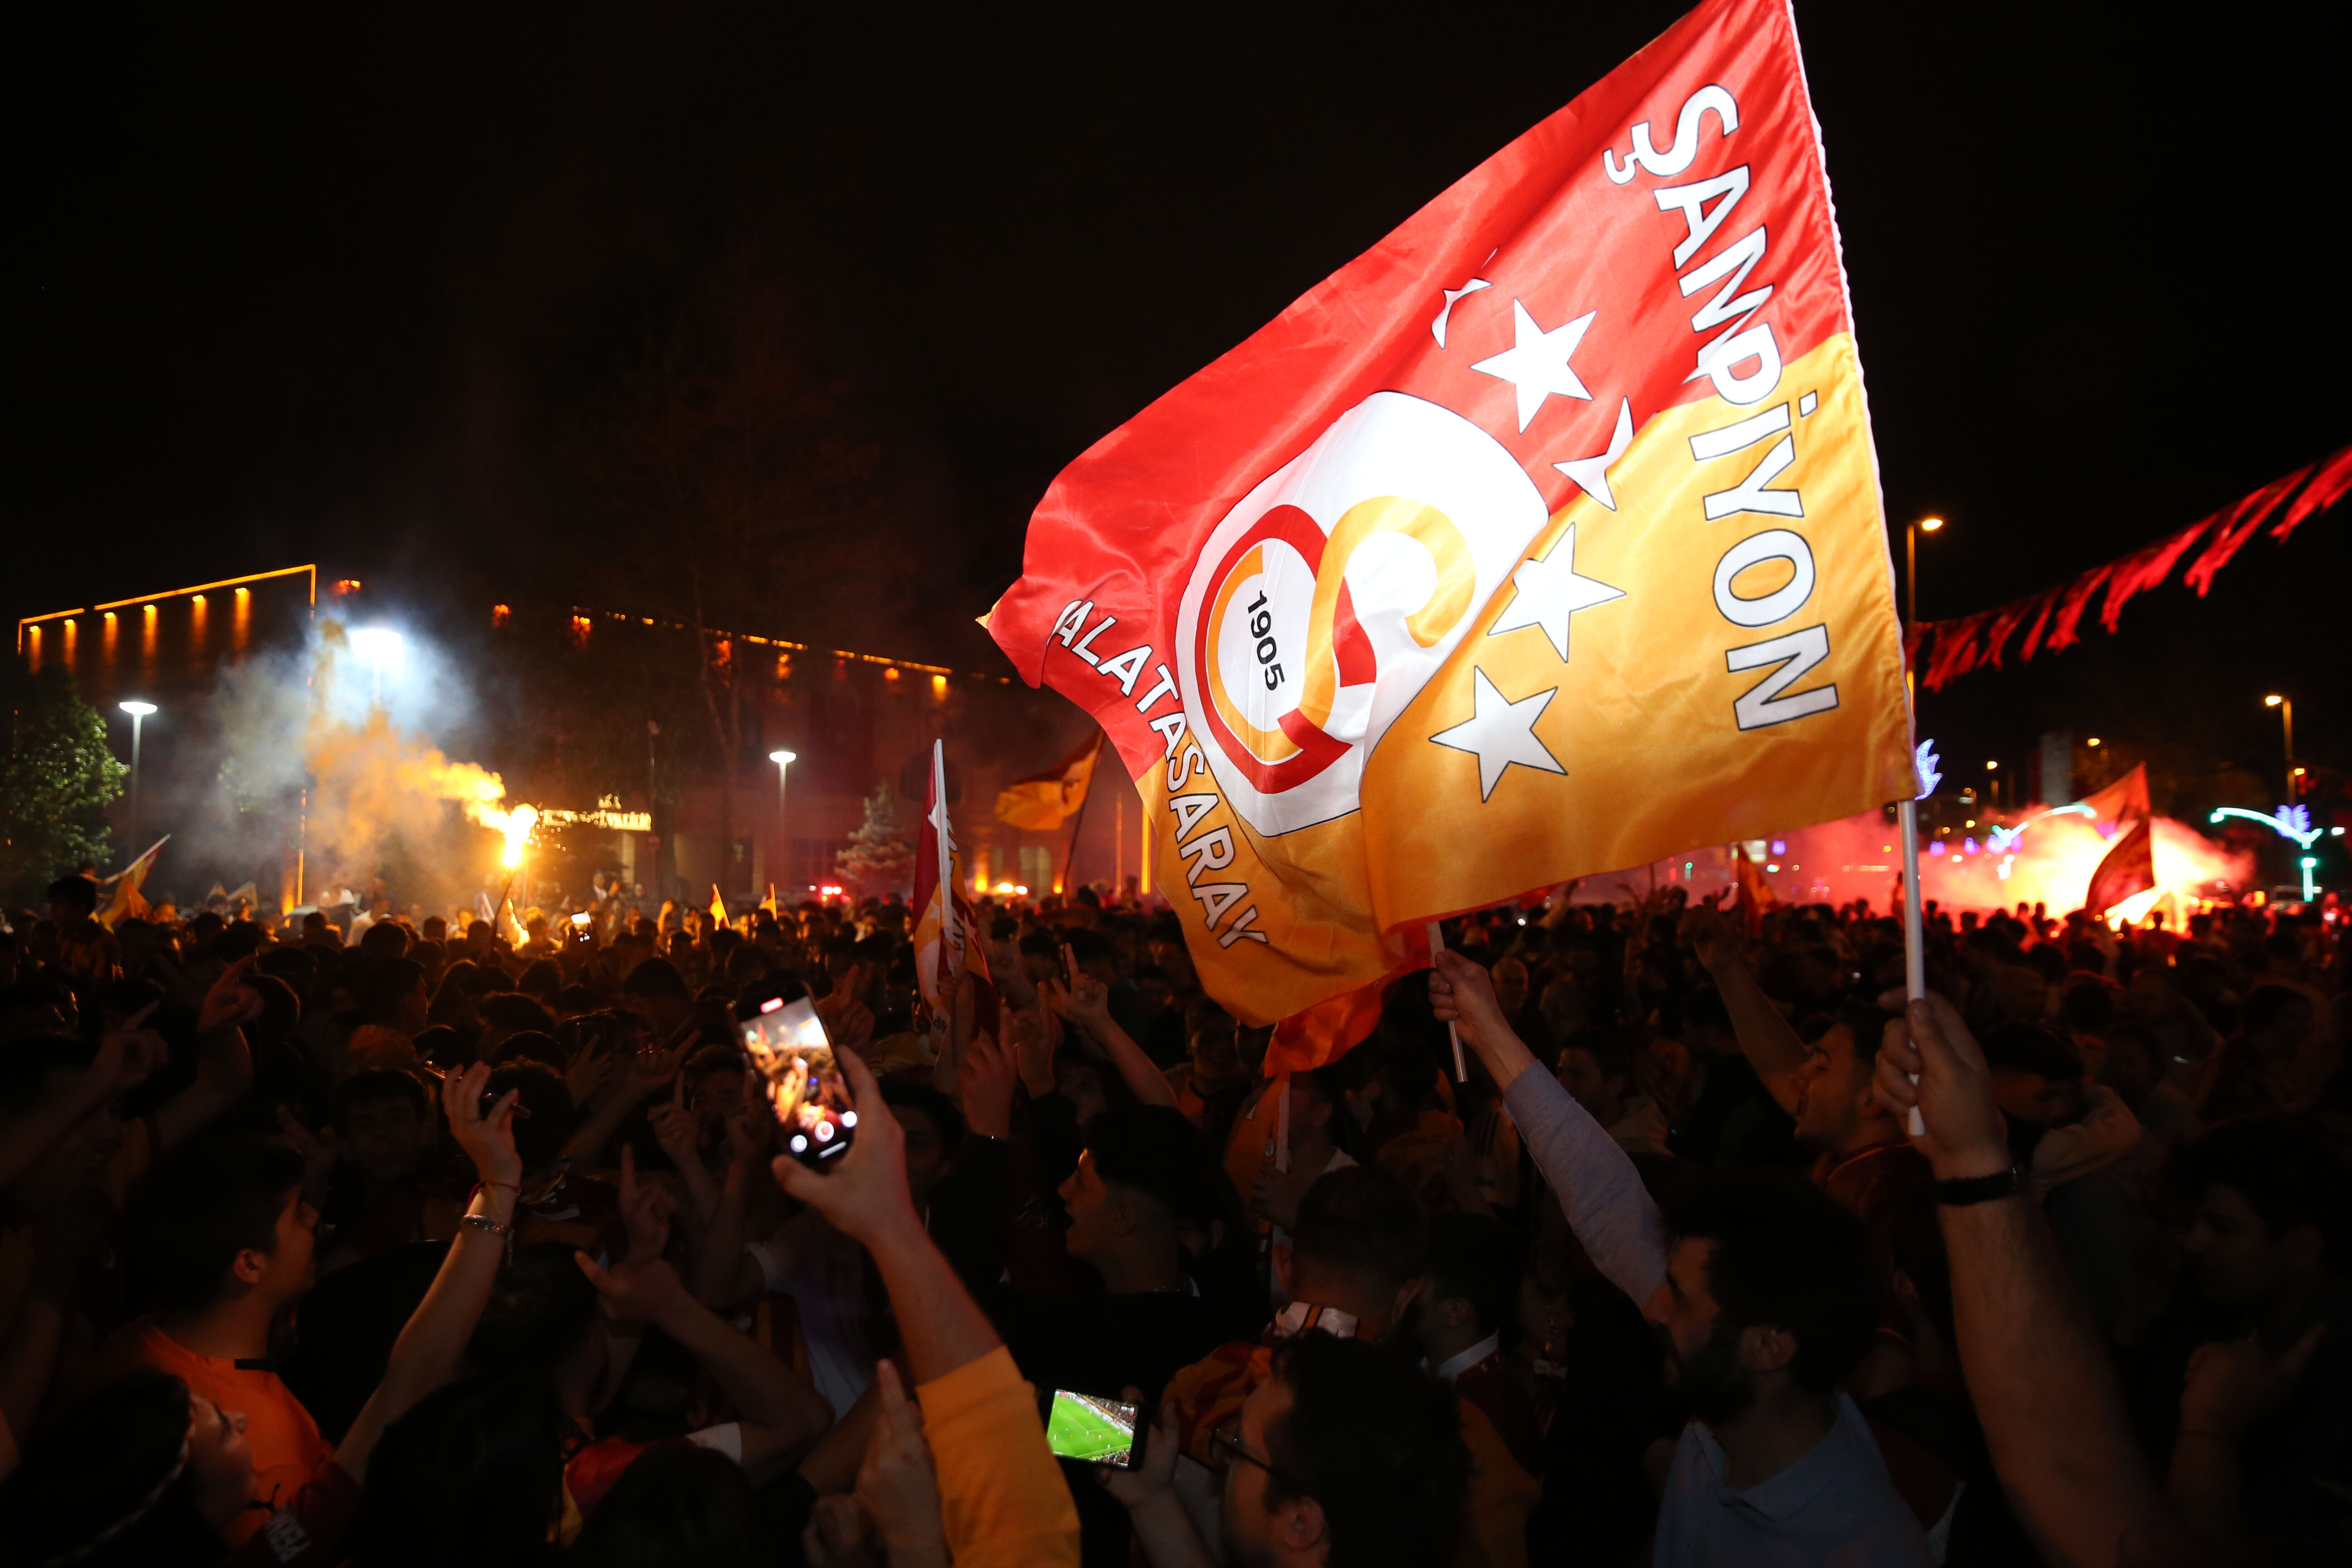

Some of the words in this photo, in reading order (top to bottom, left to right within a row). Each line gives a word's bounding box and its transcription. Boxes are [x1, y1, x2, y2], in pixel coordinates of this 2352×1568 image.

[1603, 84, 1839, 730] ŞAMPİYON
[1046, 598, 1269, 949] ALATASARAY
[1248, 590, 1285, 691] 1905
